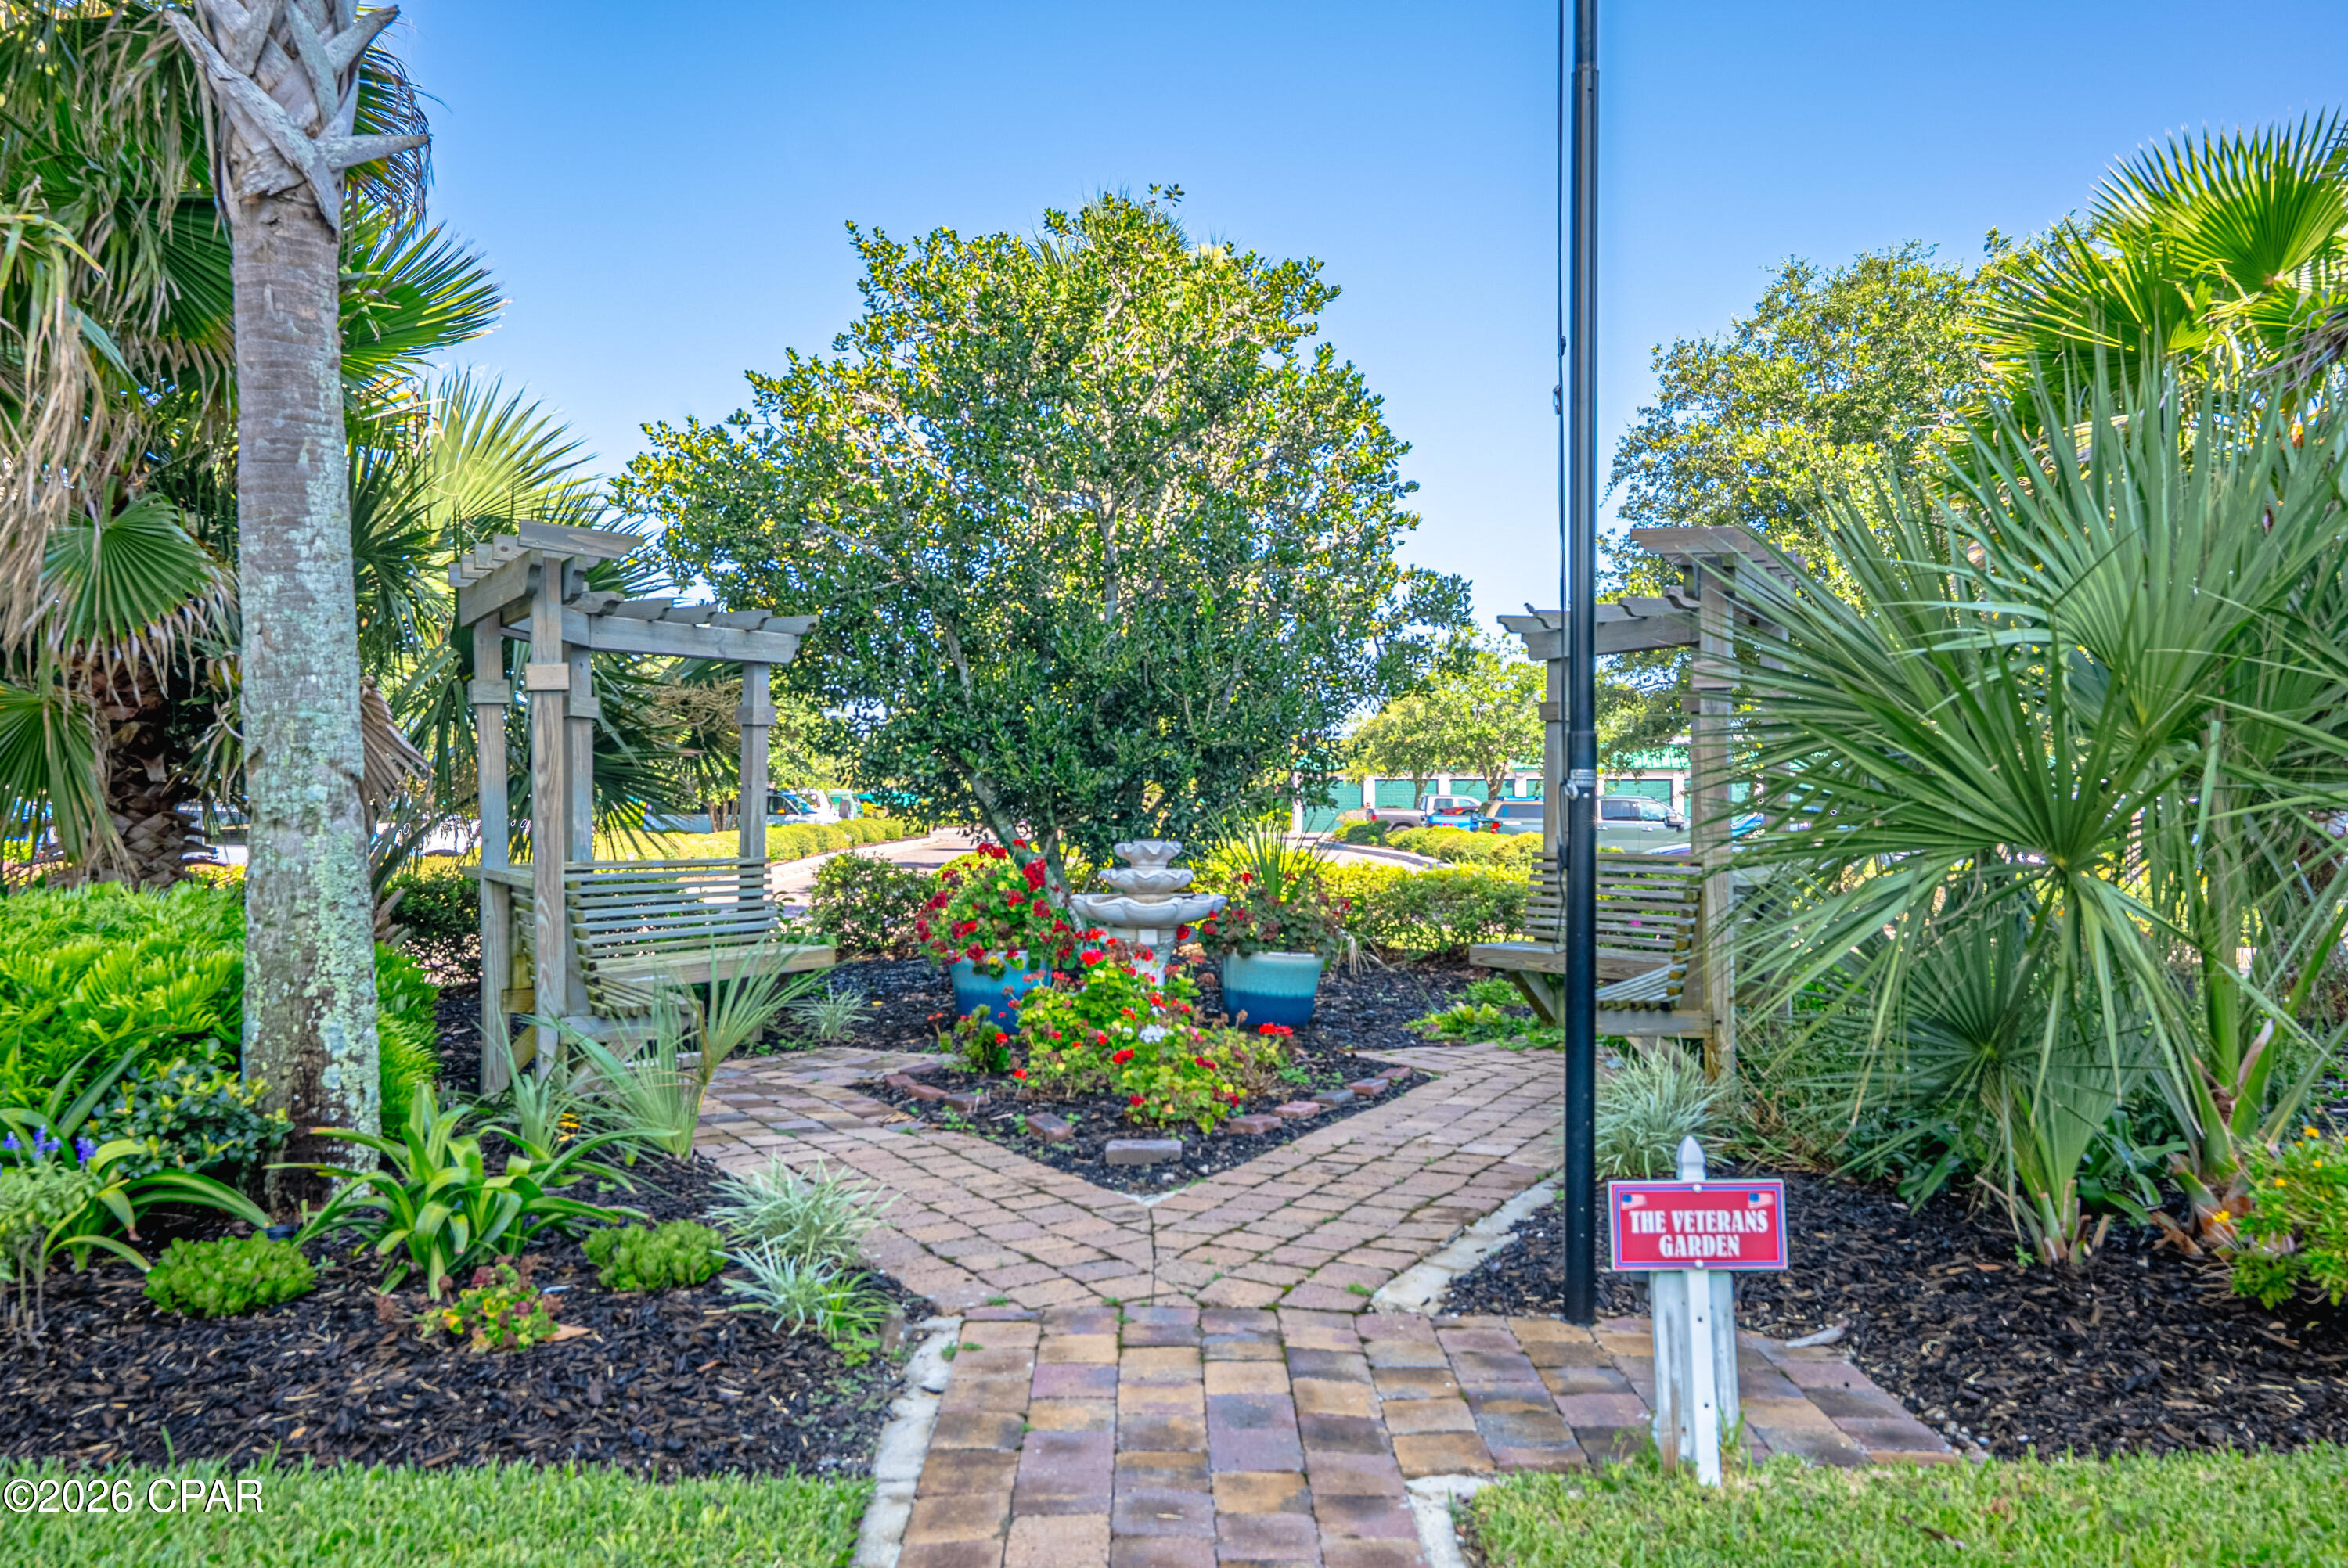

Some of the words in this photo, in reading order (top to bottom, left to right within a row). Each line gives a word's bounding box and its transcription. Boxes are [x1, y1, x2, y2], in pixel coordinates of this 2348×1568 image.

[1629, 1210, 1666, 1234] THE
[1671, 1209, 1769, 1234] VETERANS
[1658, 1234, 1741, 1257] GARDEN
